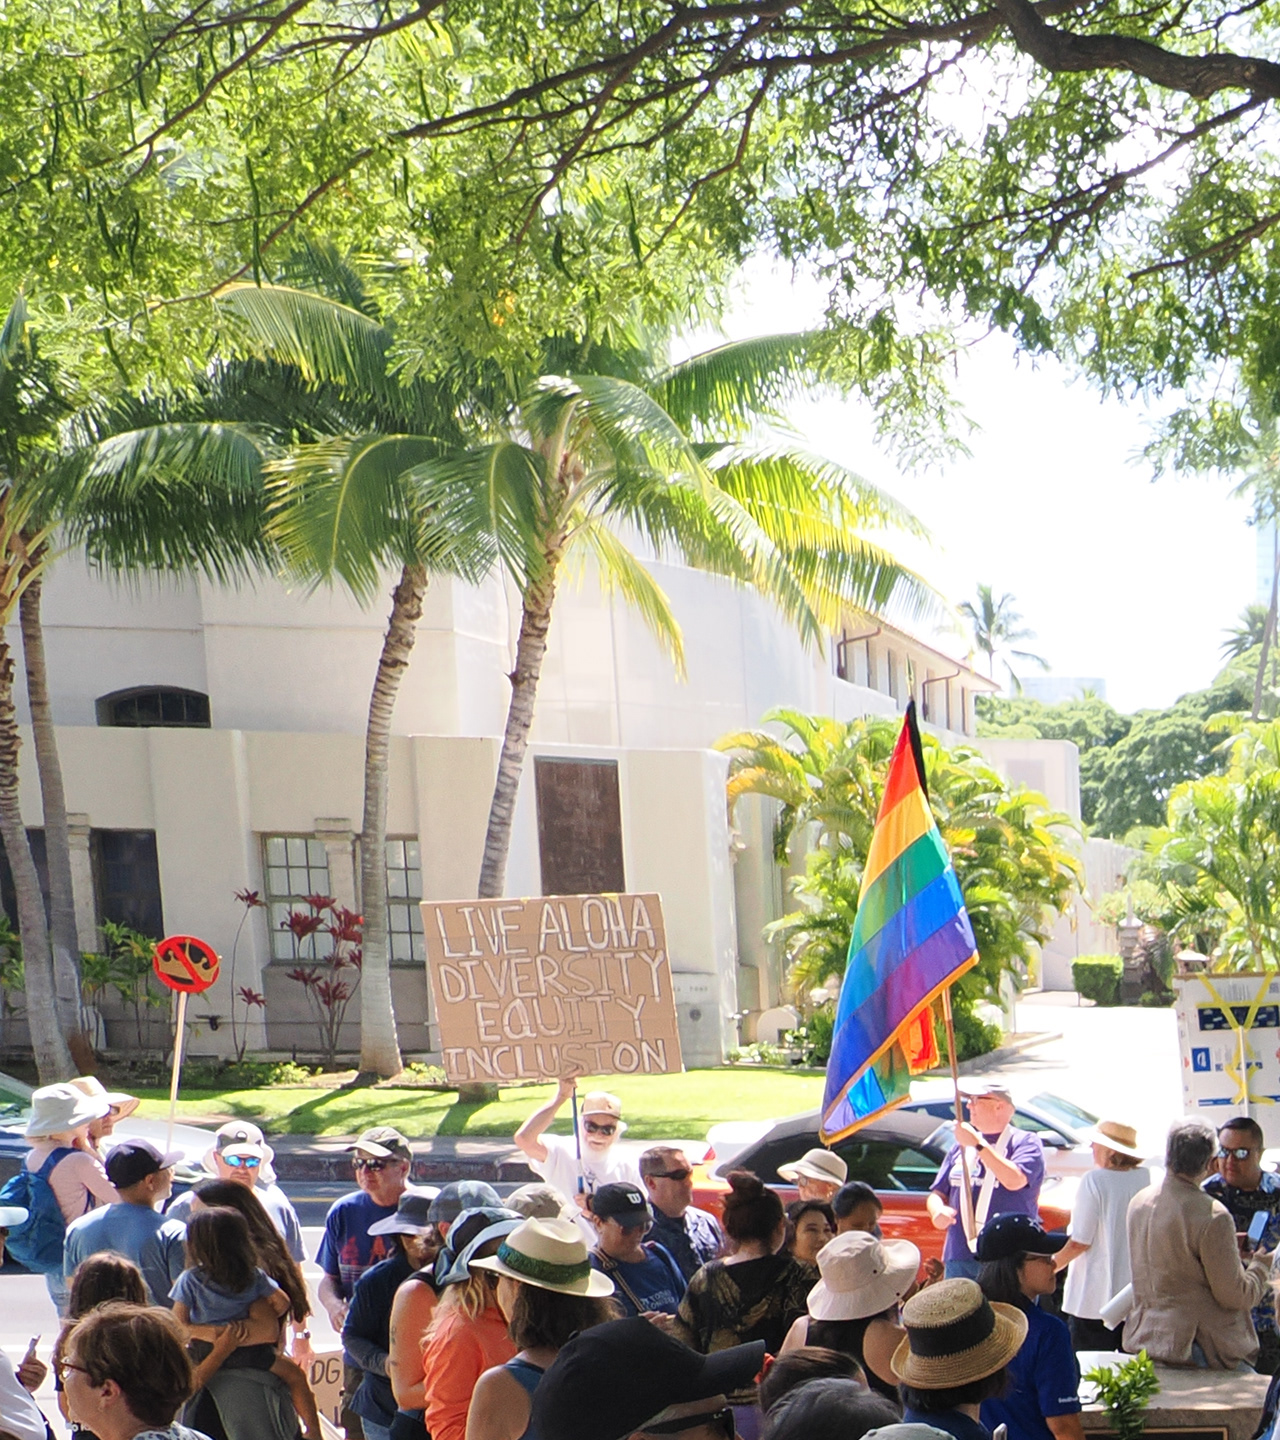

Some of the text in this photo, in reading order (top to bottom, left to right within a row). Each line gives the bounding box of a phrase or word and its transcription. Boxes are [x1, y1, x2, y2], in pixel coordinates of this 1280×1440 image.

[436, 898, 657, 958] LIVE ALOHA
[438, 950, 665, 1003] DIVERSITY
[475, 994, 647, 1043] EQUITY
[445, 1039, 668, 1081] INCLUSION
